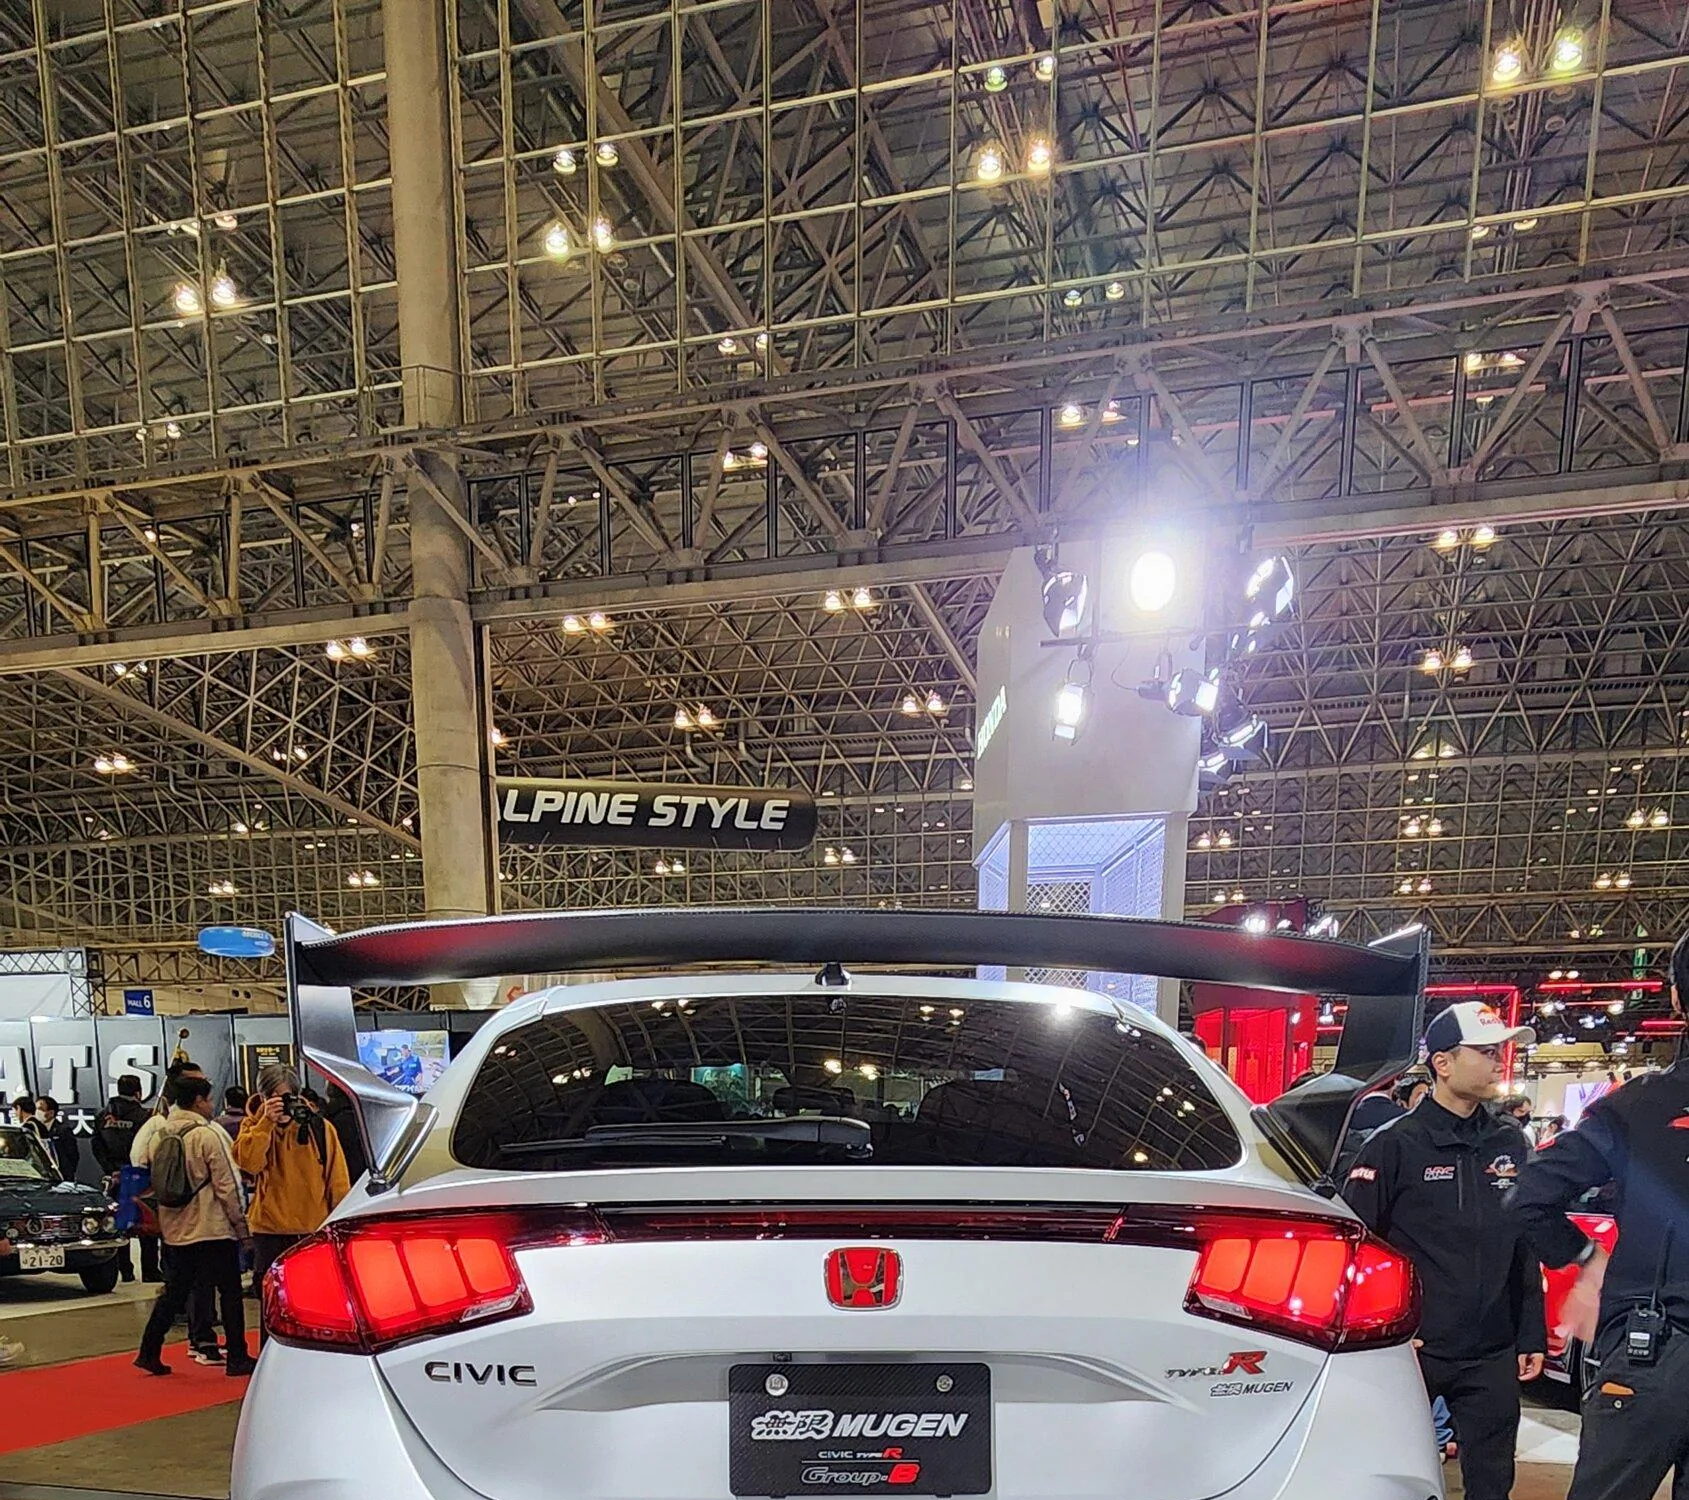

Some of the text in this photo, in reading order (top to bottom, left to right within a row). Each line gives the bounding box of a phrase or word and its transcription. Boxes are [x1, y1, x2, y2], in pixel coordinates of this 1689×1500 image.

[498, 789, 790, 831] LPINE STYLE
[127, 995, 151, 1009] HALL 6
[30, 1255, 63, 1267] 21-20
[424, 1361, 538, 1387] CIVIC
[1242, 1381, 1294, 1395] MUGEN
[752, 1410, 969, 1440] 無限 MUGEN
[818, 1451, 854, 1459] CIVIC
